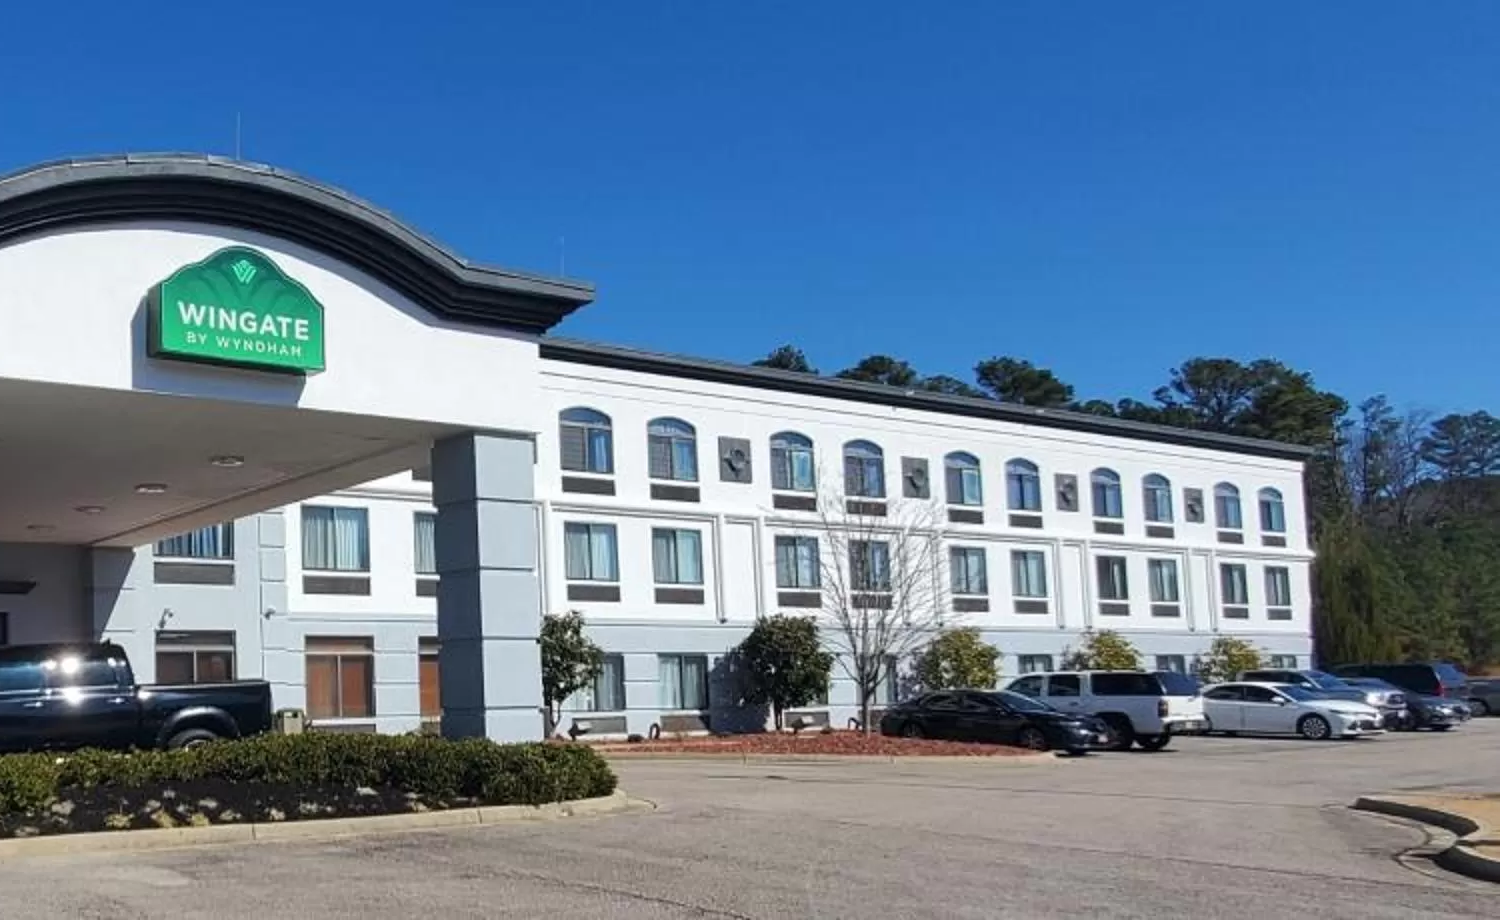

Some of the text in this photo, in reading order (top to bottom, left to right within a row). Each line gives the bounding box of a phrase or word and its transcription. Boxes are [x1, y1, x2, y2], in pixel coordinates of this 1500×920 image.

[177, 300, 310, 341] WINGATE
[186, 331, 302, 357] BY WYNDHAM
